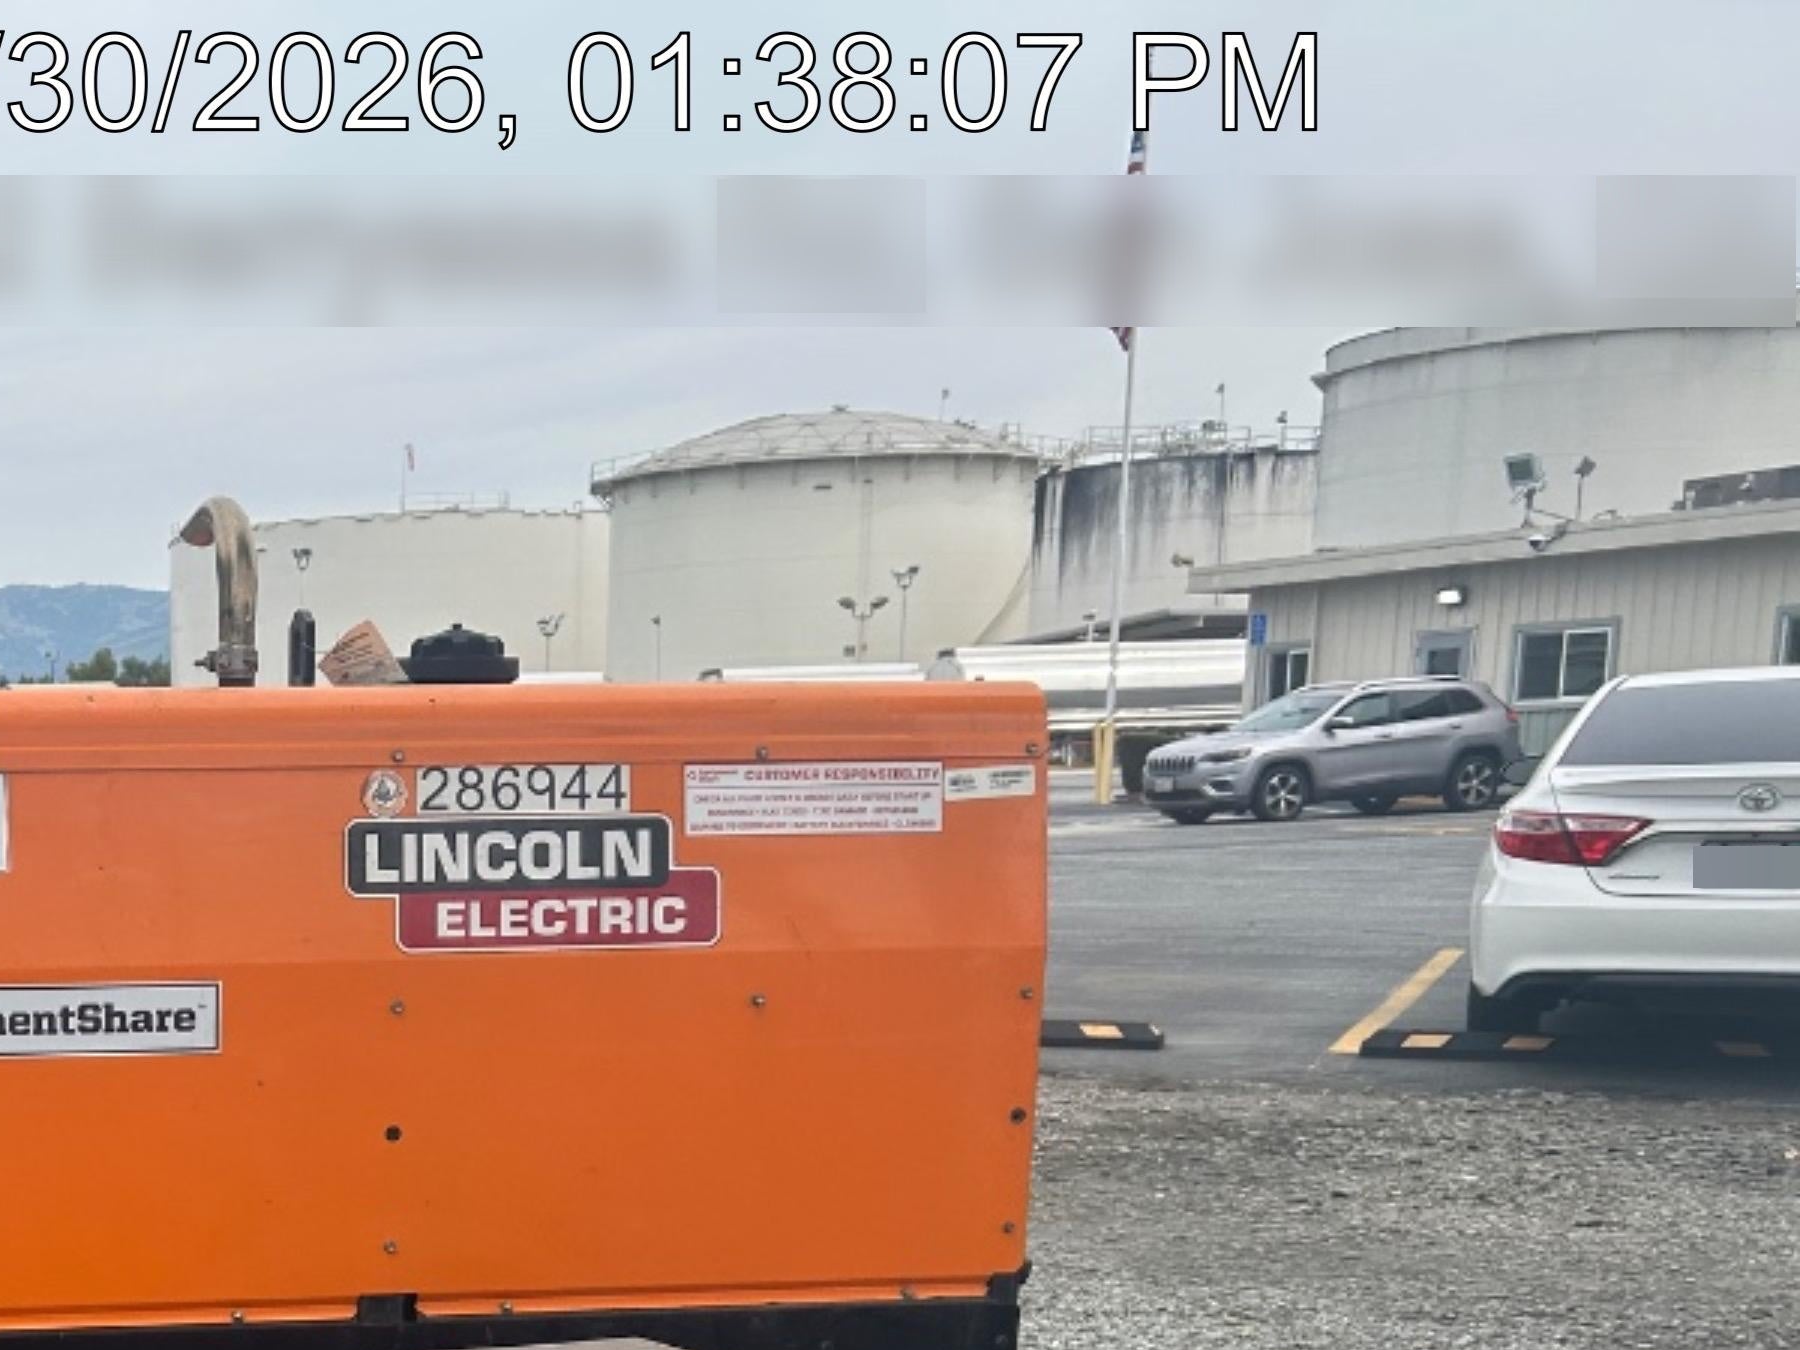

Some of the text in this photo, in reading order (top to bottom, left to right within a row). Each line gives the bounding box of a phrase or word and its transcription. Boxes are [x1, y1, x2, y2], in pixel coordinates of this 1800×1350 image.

[419, 765, 626, 812] 286944
[743, 768, 819, 781] CUSTOMER
[823, 766, 940, 781] RESPONSIBILITY
[365, 828, 651, 883] LINCOLN
[437, 896, 686, 938] ELECTRIC
